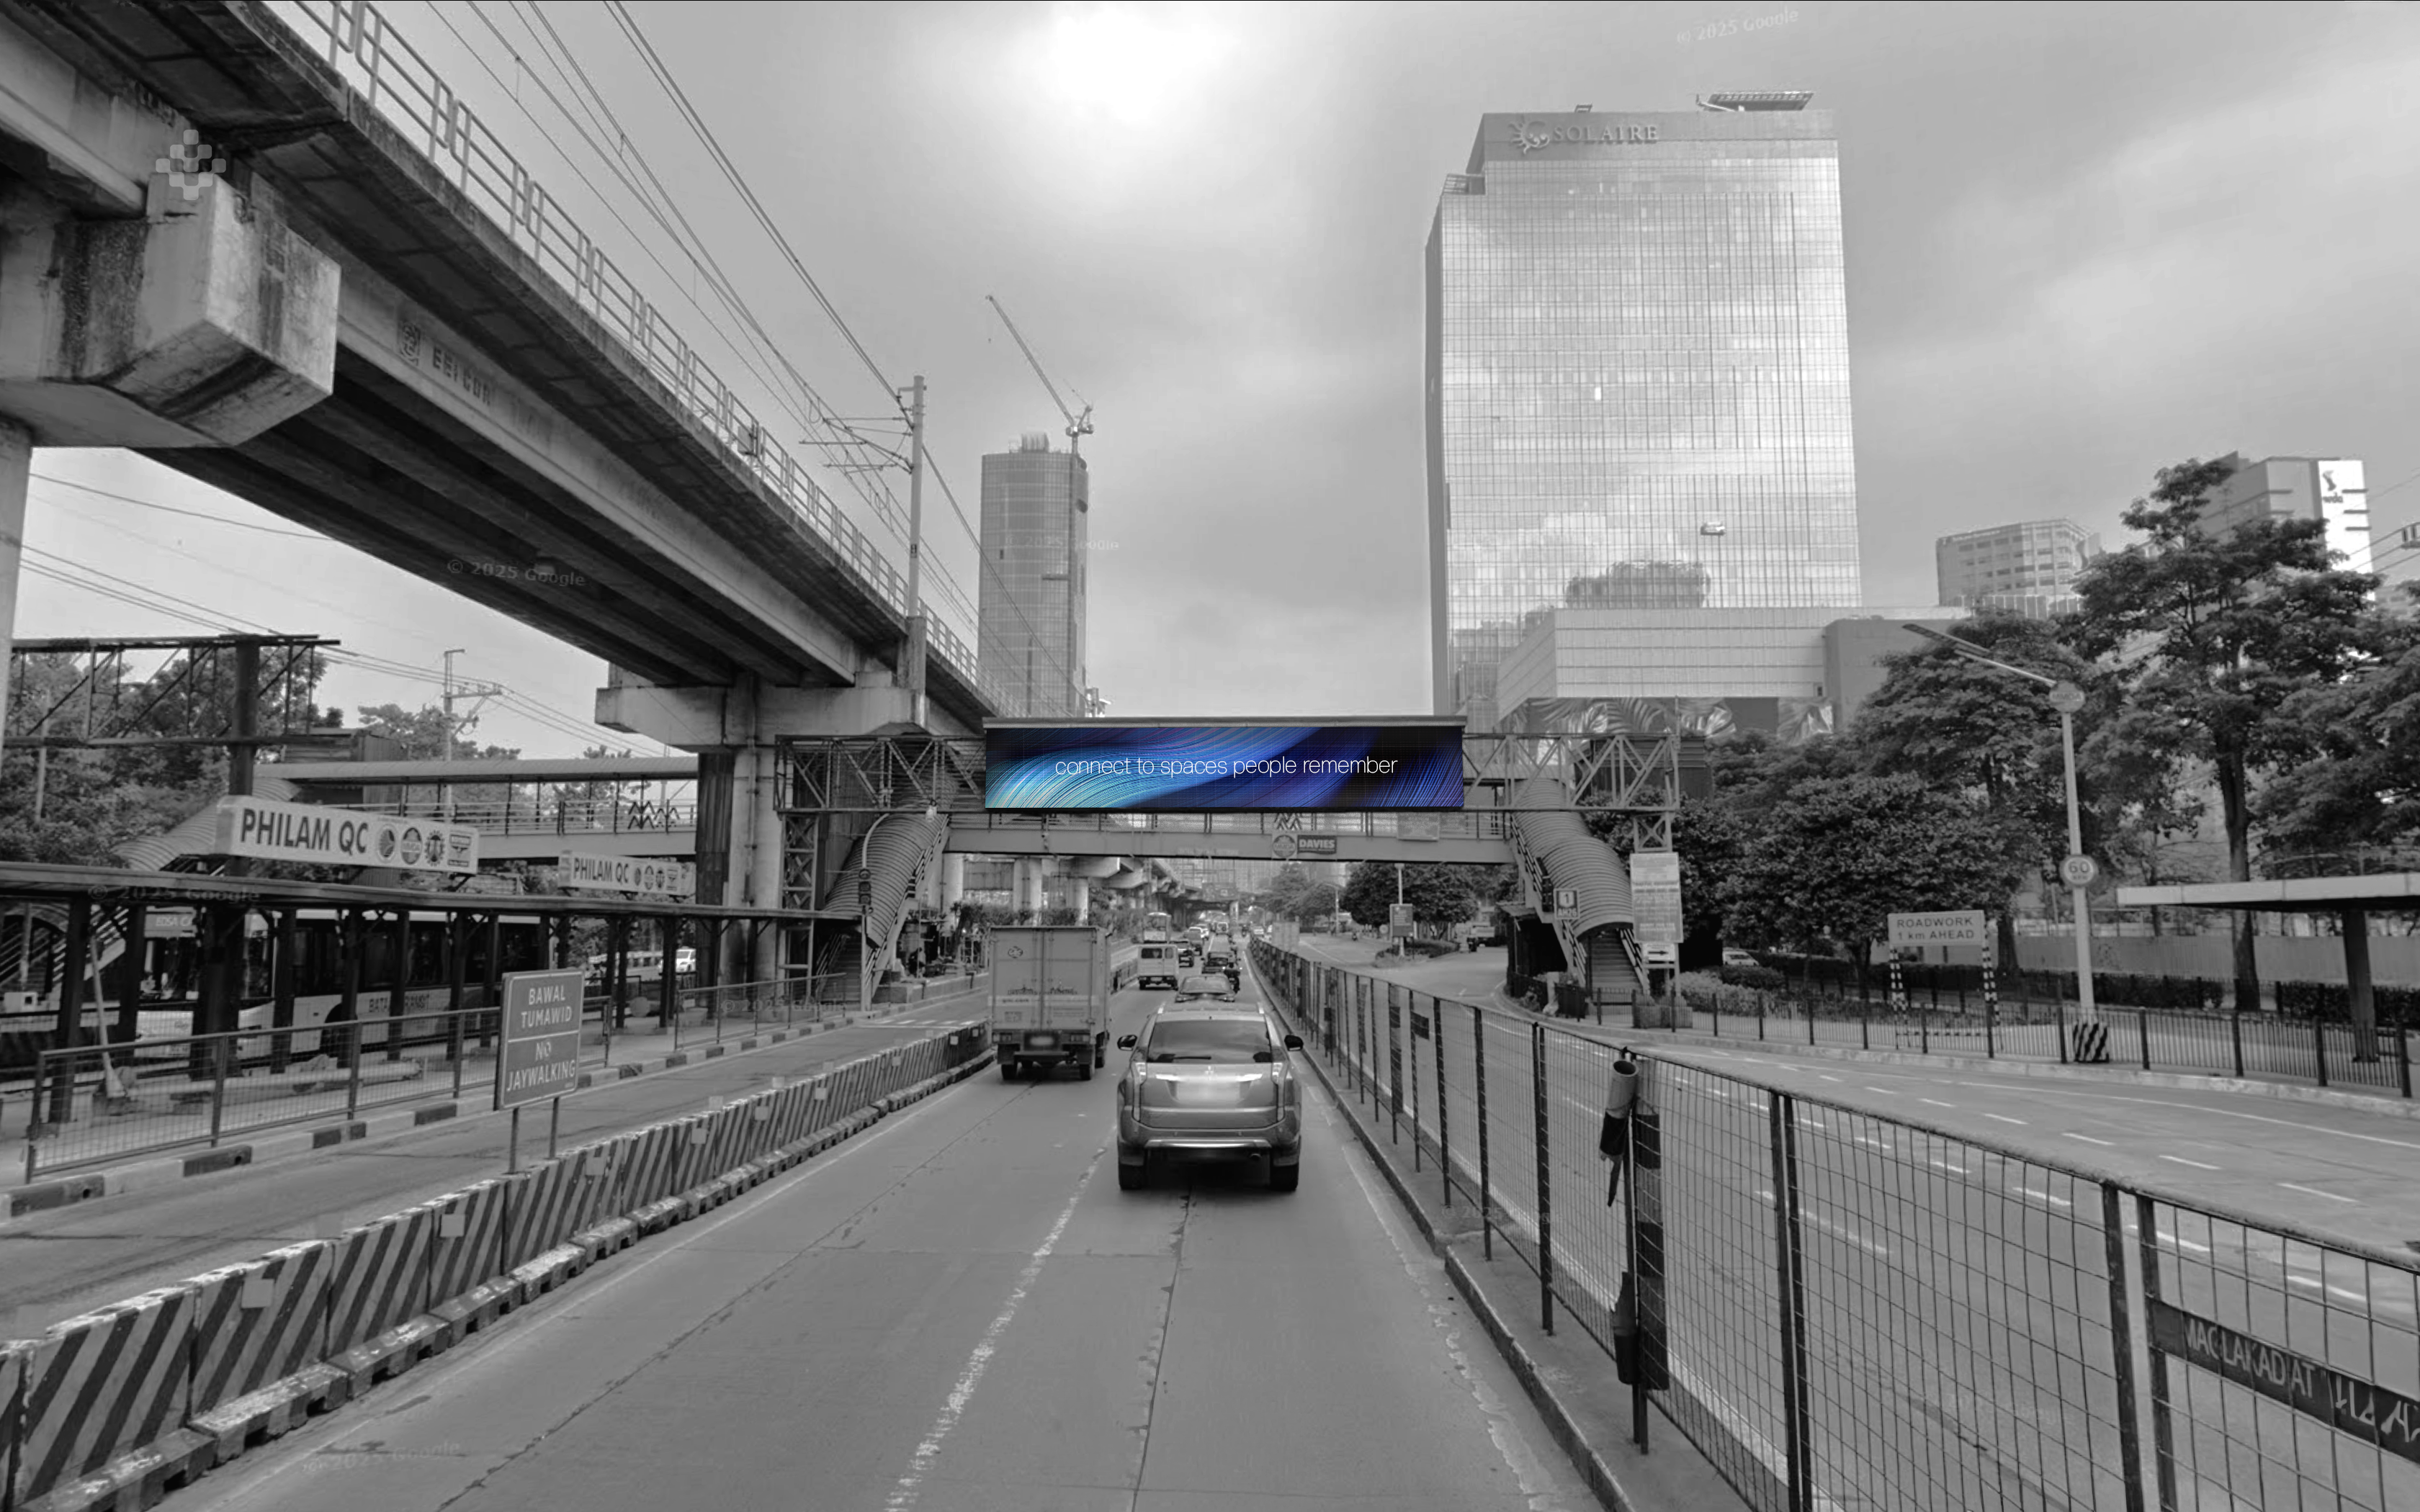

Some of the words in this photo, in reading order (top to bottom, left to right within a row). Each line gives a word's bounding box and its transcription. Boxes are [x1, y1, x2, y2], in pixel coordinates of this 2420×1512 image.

[1553, 124, 1659, 144] SOLAIRE
[1055, 757, 1131, 775] connect
[1136, 757, 1155, 775] to
[1160, 760, 1227, 778] spaces
[1234, 756, 1297, 778] people
[1303, 756, 1398, 774] remember
[241, 808, 331, 852] PHILAM
[339, 821, 369, 855] QC
[1299, 839, 1335, 849] DAVIES
[573, 857, 613, 882] PHILAM
[616, 862, 629, 886] QC
[2068, 861, 2090, 873] 60
[1564, 894, 1569, 905] 1
[1896, 917, 1973, 928] ROADWORK
[1898, 932, 1902, 940] 1
[1908, 931, 1924, 940] km
[1930, 929, 1974, 940] AHEAD
[528, 985, 565, 1006] BAWAL
[521, 1006, 573, 1029] TUMAWID
[535, 1041, 552, 1062] NO
[506, 1059, 575, 1092] JAYWALKING
